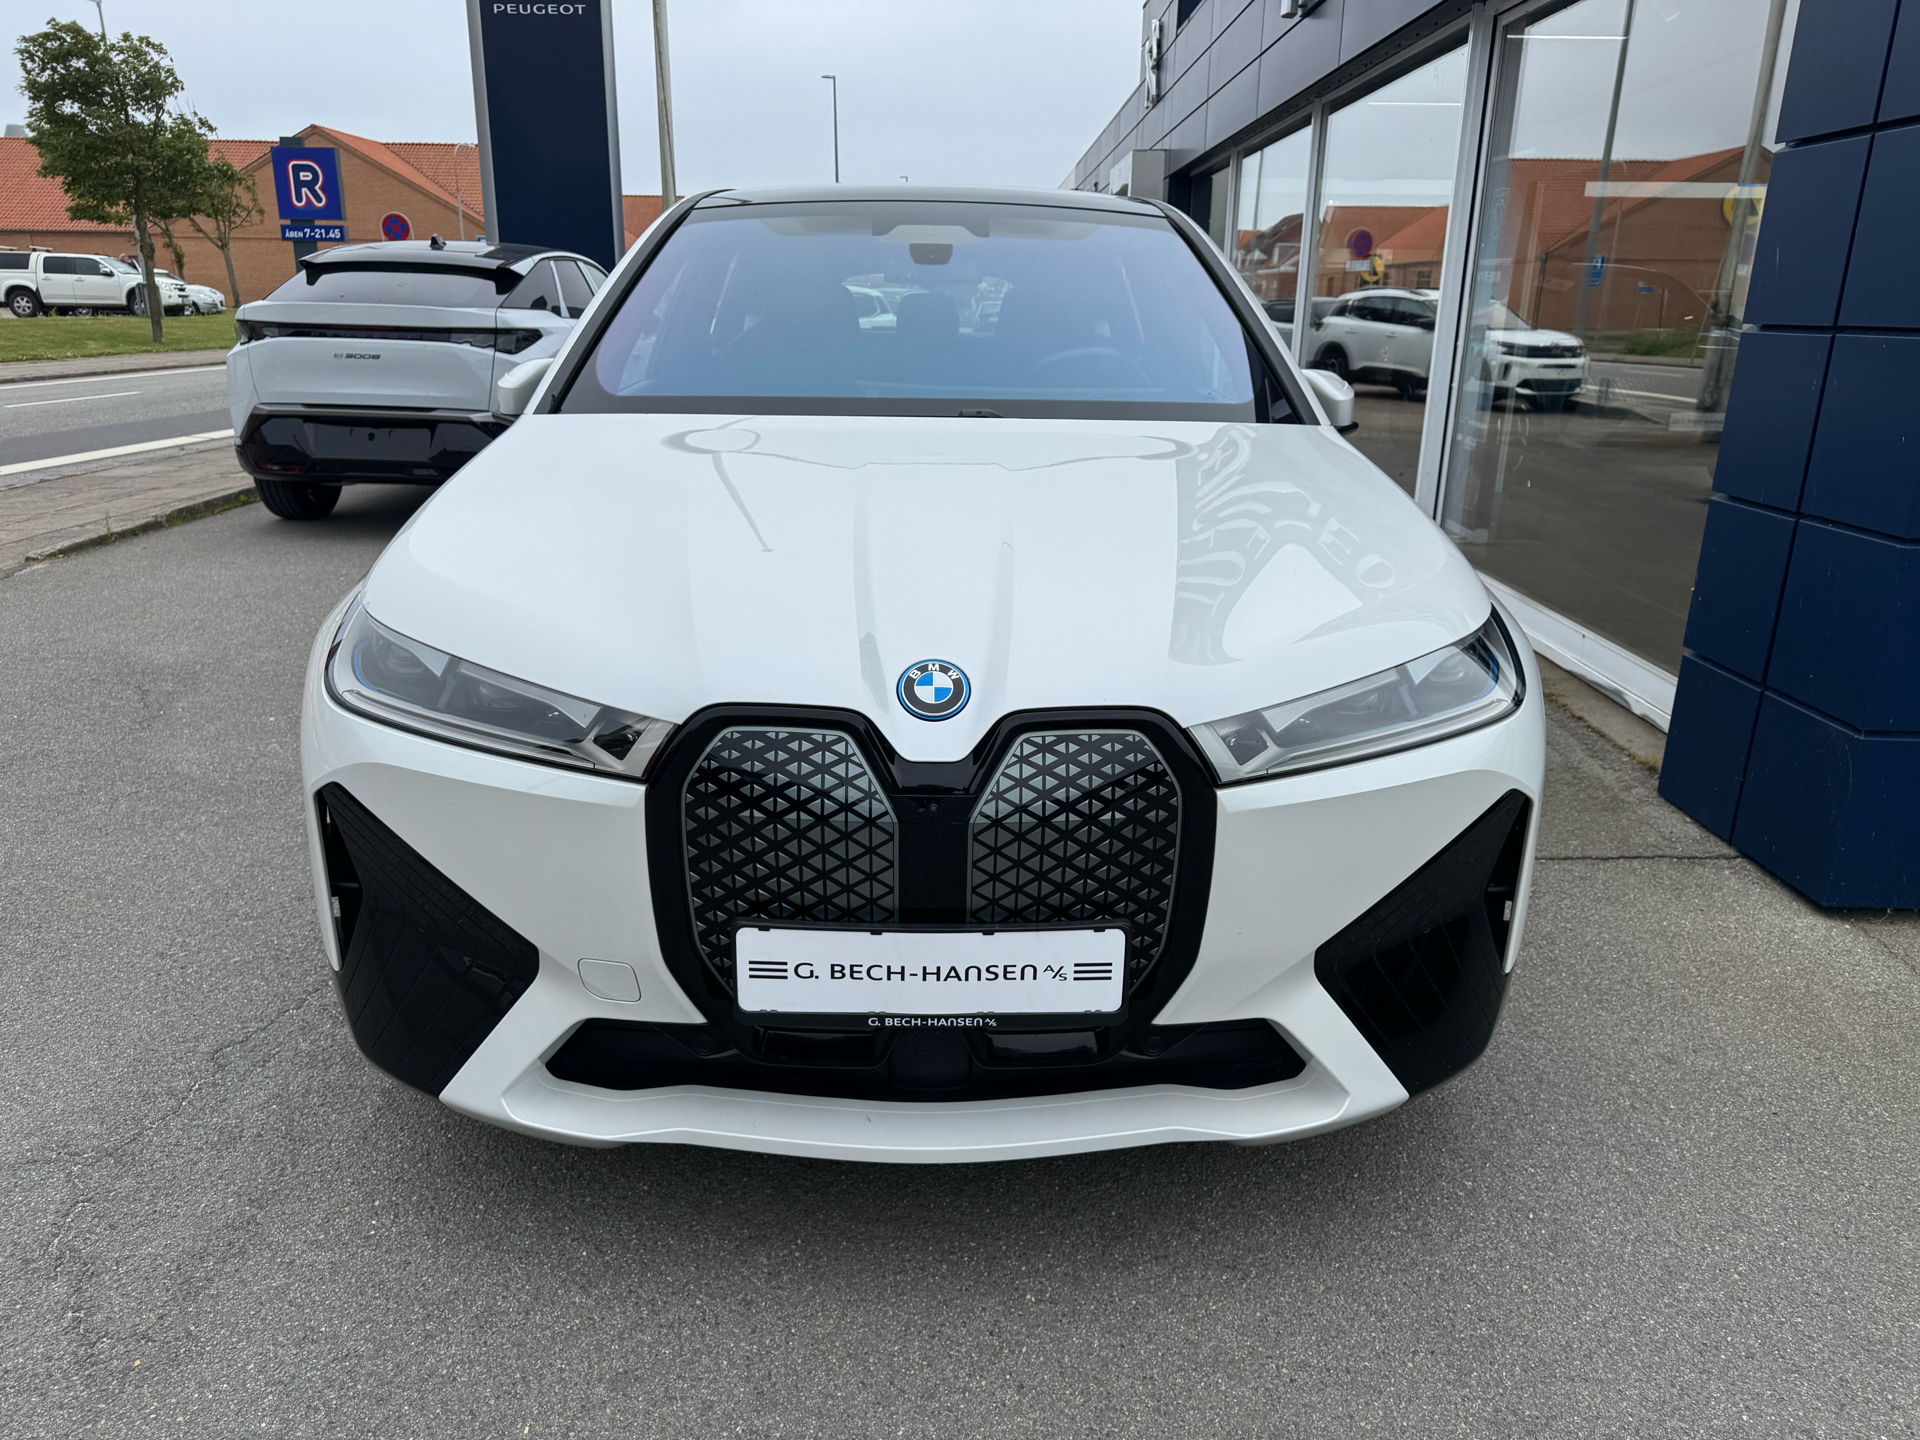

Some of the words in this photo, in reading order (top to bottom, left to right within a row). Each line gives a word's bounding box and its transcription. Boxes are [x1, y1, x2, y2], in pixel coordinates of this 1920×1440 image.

[493, 3, 586, 15] PEUGEOT
[287, 158, 328, 209] R
[285, 228, 304, 238] ÅBEN
[304, 228, 341, 239] 7-21.45
[909, 663, 960, 680] BMW
[794, 962, 820, 980] G.
[830, 963, 1038, 982] BECH-HANSEN
[1043, 964, 1068, 982] A/S
[868, 1017, 881, 1027] G.
[885, 1017, 983, 1027] BECH-HANSEN
[984, 1018, 997, 1027] A/S
